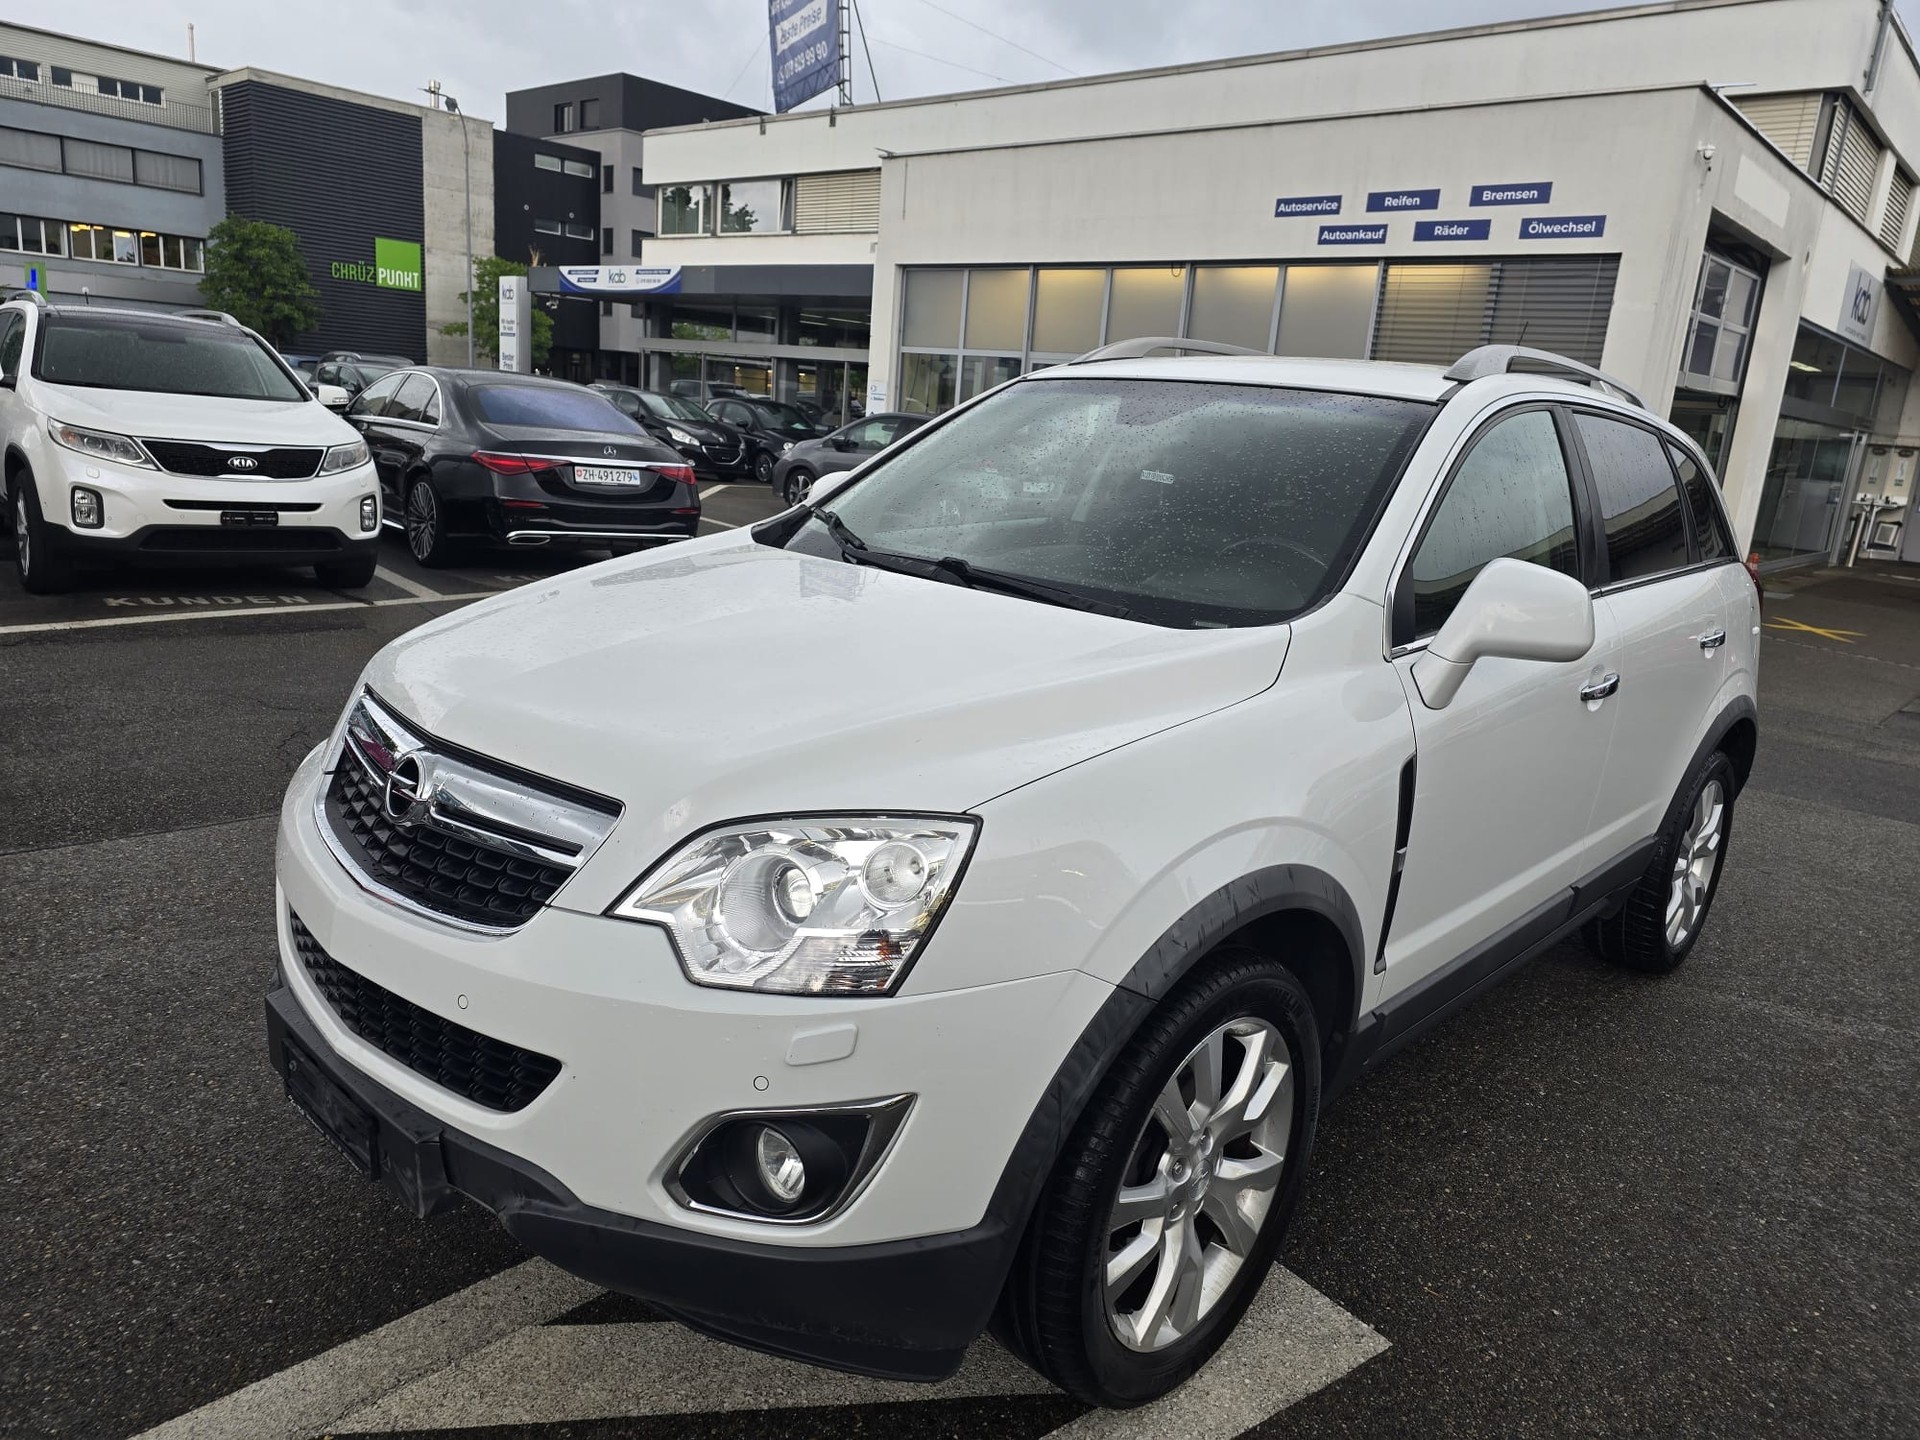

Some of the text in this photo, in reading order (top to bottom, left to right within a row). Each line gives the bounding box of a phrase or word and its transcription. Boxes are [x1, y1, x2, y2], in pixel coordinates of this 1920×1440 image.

[799, 7, 822, 33] Preise
[816, 40, 828, 60] 90
[1384, 195, 1420, 207] Reifen
[1482, 188, 1538, 201] Bremsen
[1277, 200, 1338, 213] Autoservice
[1434, 224, 1470, 236] Räder
[1528, 220, 1596, 234] Ölwechsel
[1321, 228, 1384, 241] Autoankauf
[233, 458, 253, 468] KIA
[103, 594, 310, 607] KUNDEN
